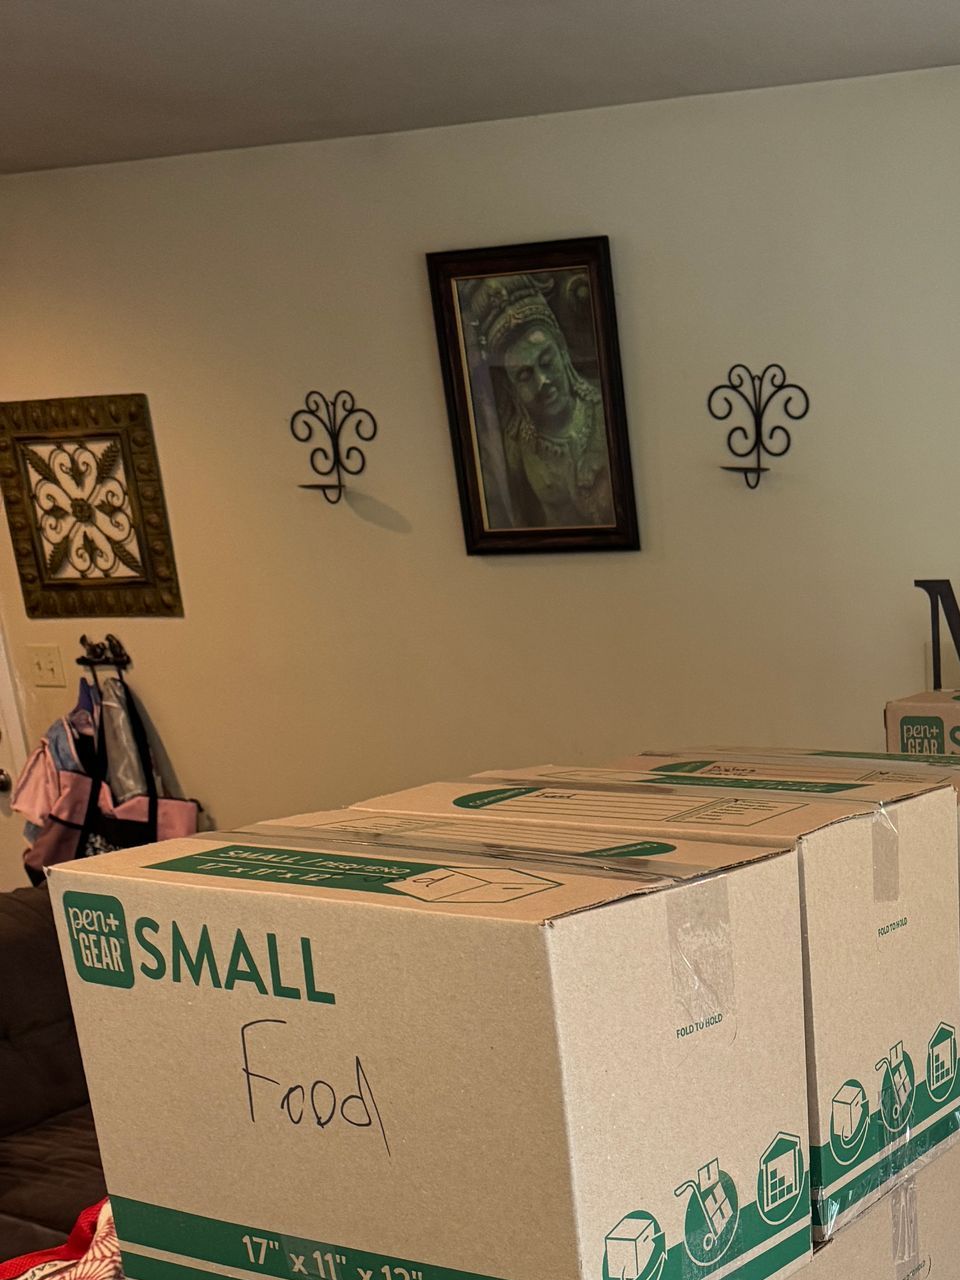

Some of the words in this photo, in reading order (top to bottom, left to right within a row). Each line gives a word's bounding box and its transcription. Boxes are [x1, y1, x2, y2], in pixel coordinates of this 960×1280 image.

[902, 721, 940, 745] pen+
[906, 739, 939, 755] GEAR
[68, 906, 120, 941] pen+
[79, 935, 125, 973] GEAR
[134, 916, 336, 1005] SMALL
[676, 1023, 695, 1039] FOLD
[694, 1021, 705, 1032] TO
[705, 1013, 723, 1028] HOLD
[241, 1017, 391, 1158] Food
[241, 1234, 280, 1265] 17"
[289, 1252, 308, 1275] x
[312, 1250, 347, 1280] 11"
